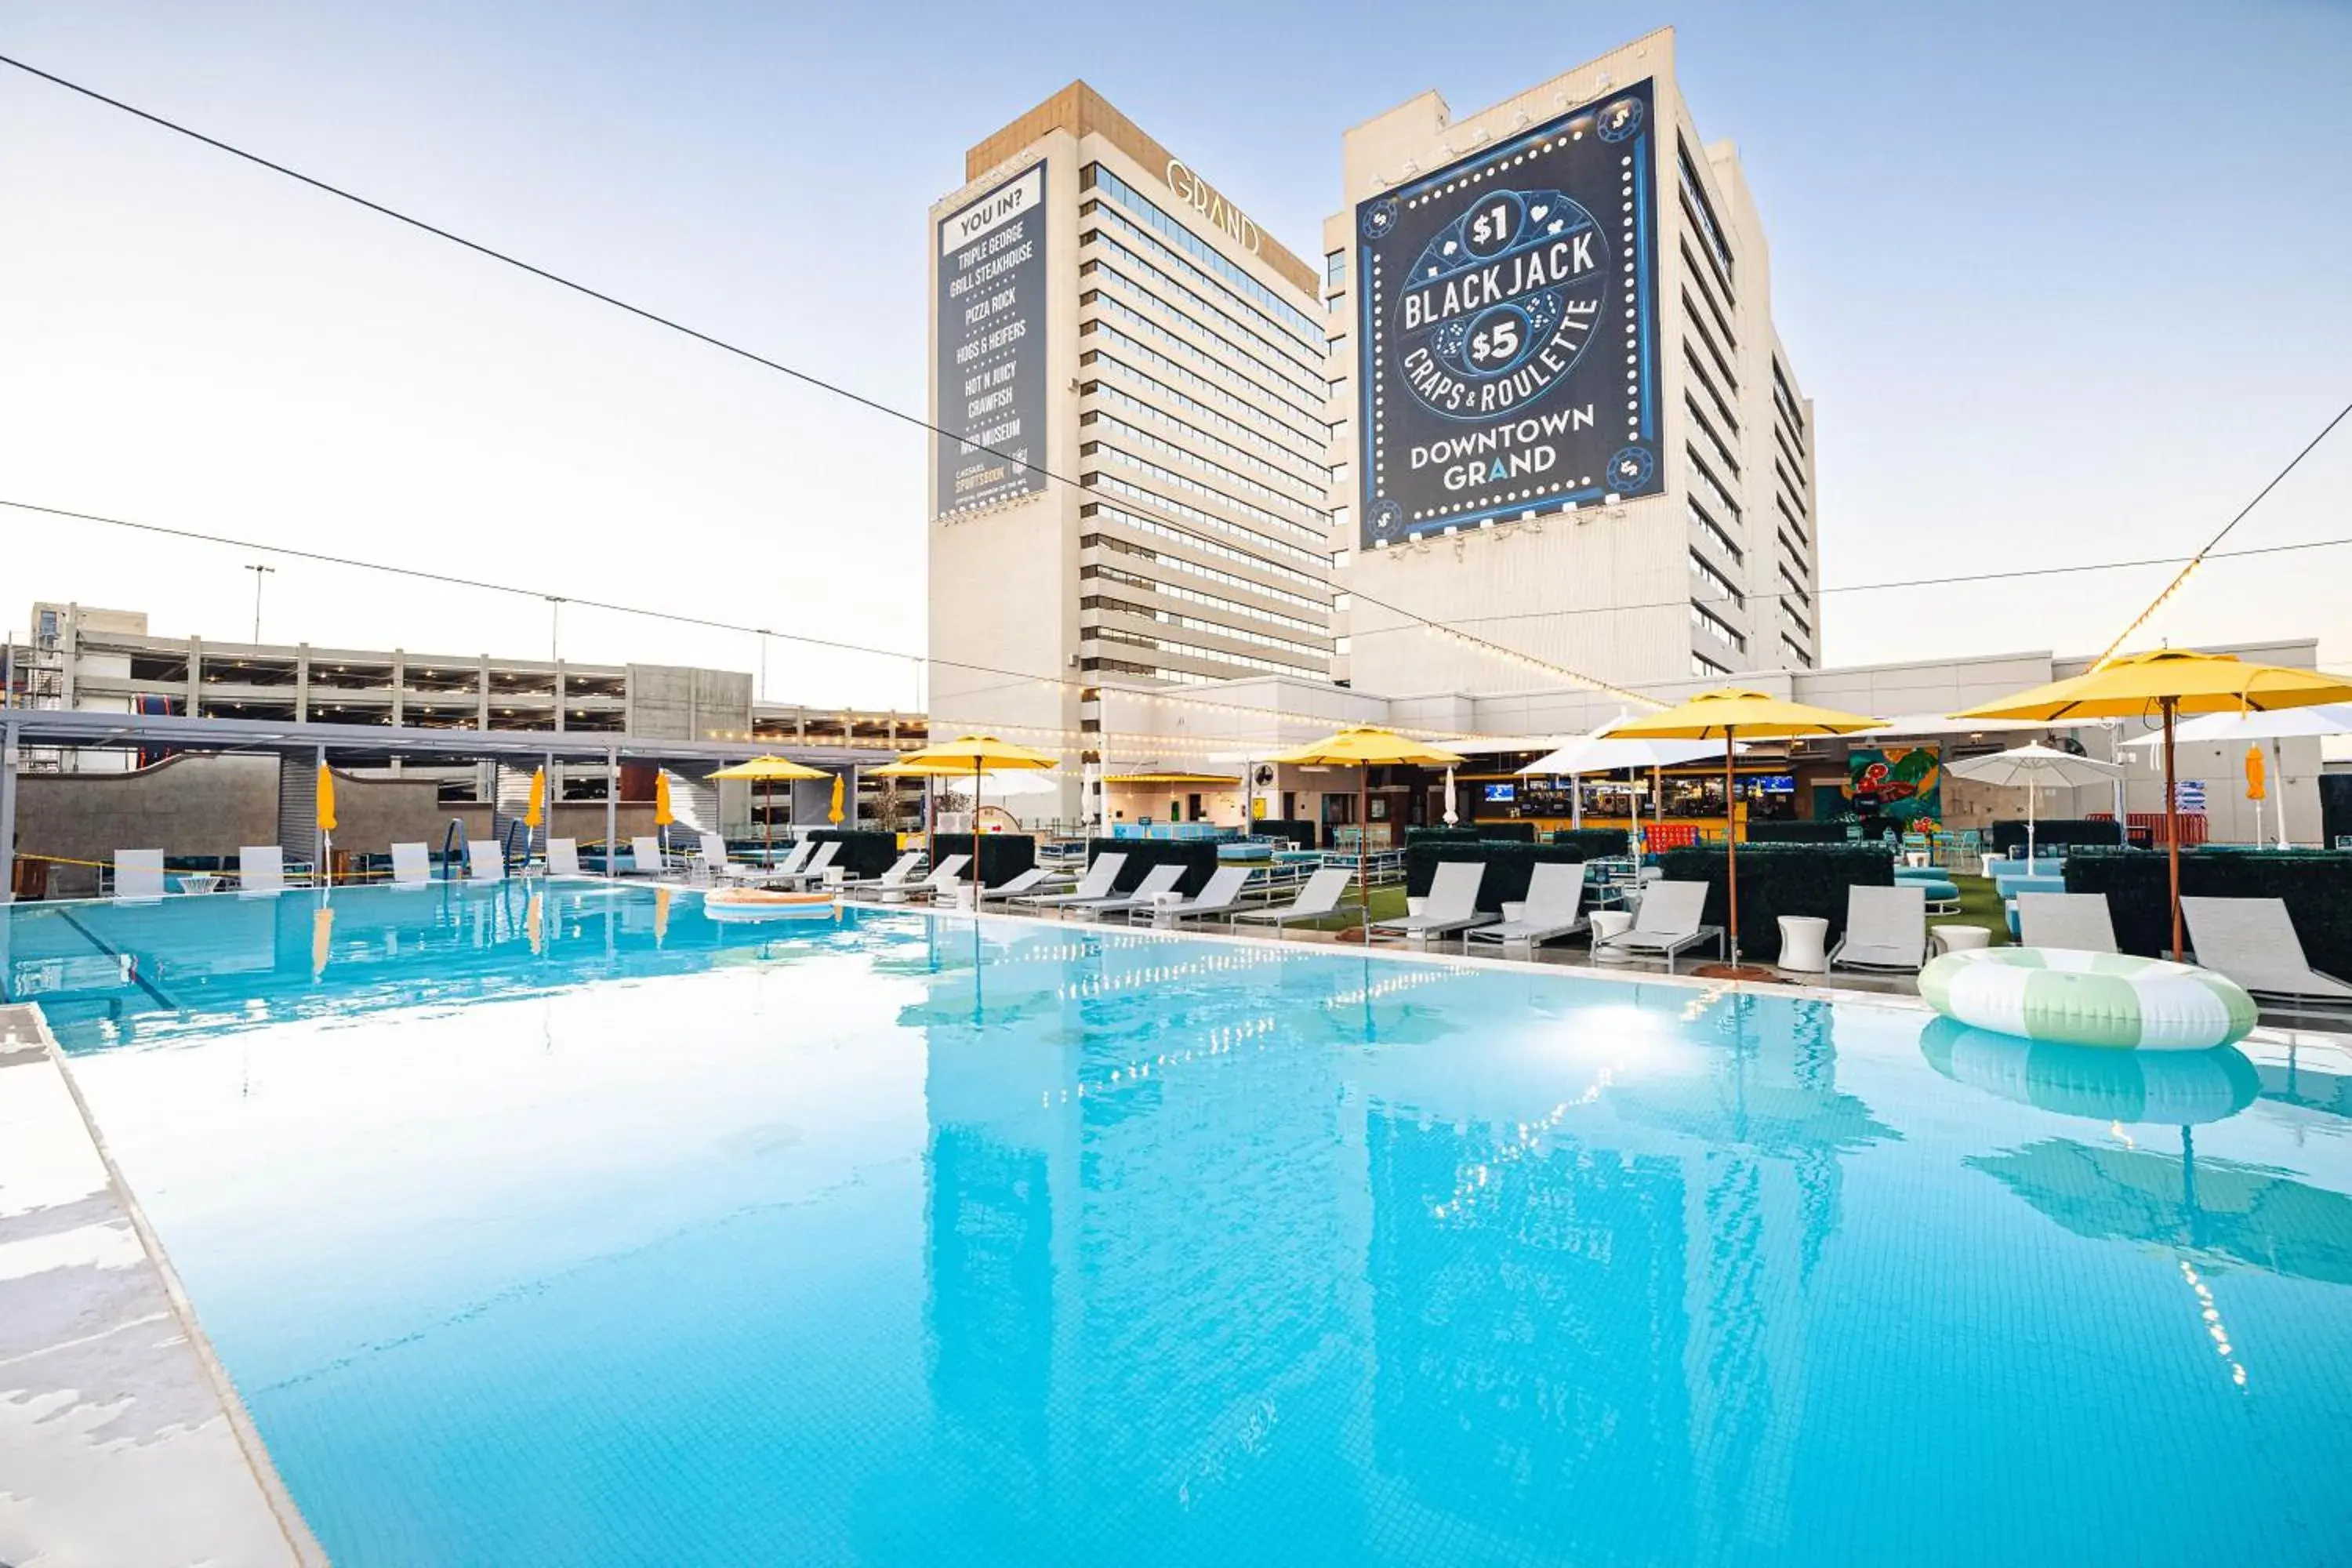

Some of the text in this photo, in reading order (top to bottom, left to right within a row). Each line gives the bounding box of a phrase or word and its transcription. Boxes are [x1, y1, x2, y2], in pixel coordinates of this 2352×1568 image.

[960, 188, 1023, 236] YOU IN?
[1167, 159, 1259, 255] GRAND
[1472, 205, 1507, 245] $1
[958, 221, 1024, 270] TRIPLE GEORGE
[949, 241, 1033, 298] GRILL STEAKHOUSE
[1405, 231, 1595, 329] BLACKJACK
[965, 287, 1016, 325] PIZZA ROCK
[956, 319, 1026, 364] HOGS & HEIFERS
[1403, 299, 1597, 412] CRAPS & ROULETTE
[1472, 321, 1519, 362] $5
[965, 360, 1017, 397] HOT N JUICY
[968, 386, 1013, 419] CRAWFISH
[981, 418, 1020, 447] MUSEUM
[1411, 404, 1595, 470] DOWNTOWN
[1443, 445, 1556, 491] GRAND
